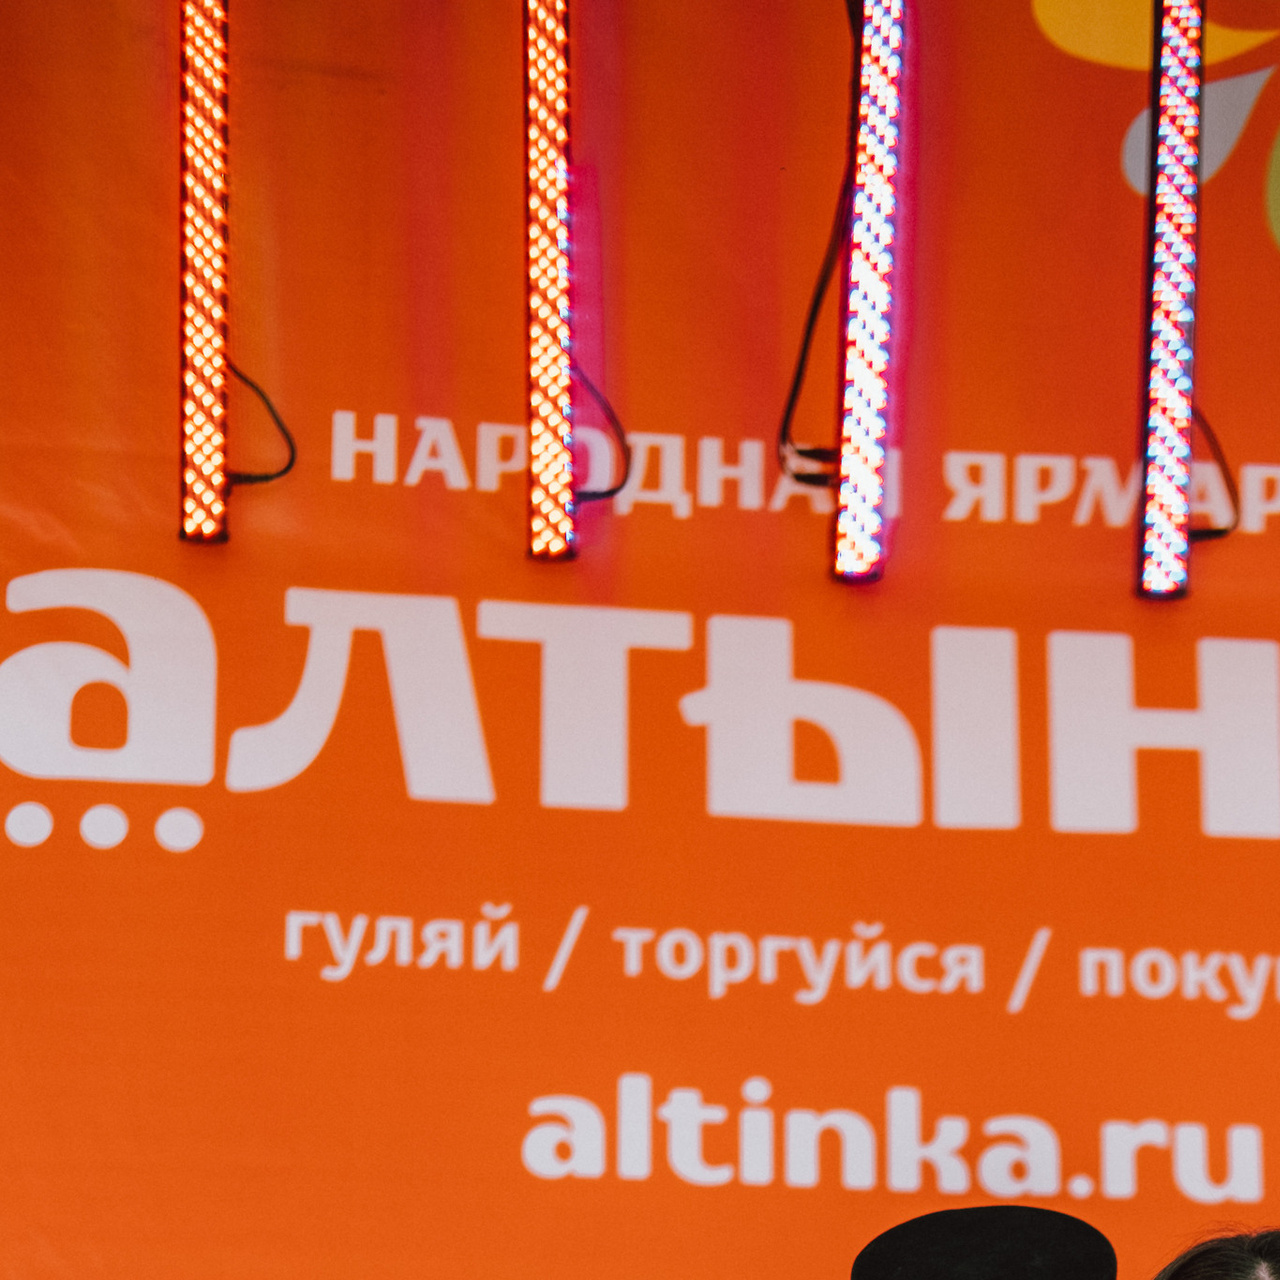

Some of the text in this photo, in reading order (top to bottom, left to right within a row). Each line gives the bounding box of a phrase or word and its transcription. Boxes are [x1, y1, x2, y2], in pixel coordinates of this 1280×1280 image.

[284, 901, 520, 983] гуляй
[611, 921, 985, 1006] торгуйся
[520, 1071, 1265, 1205] altinka.ru
